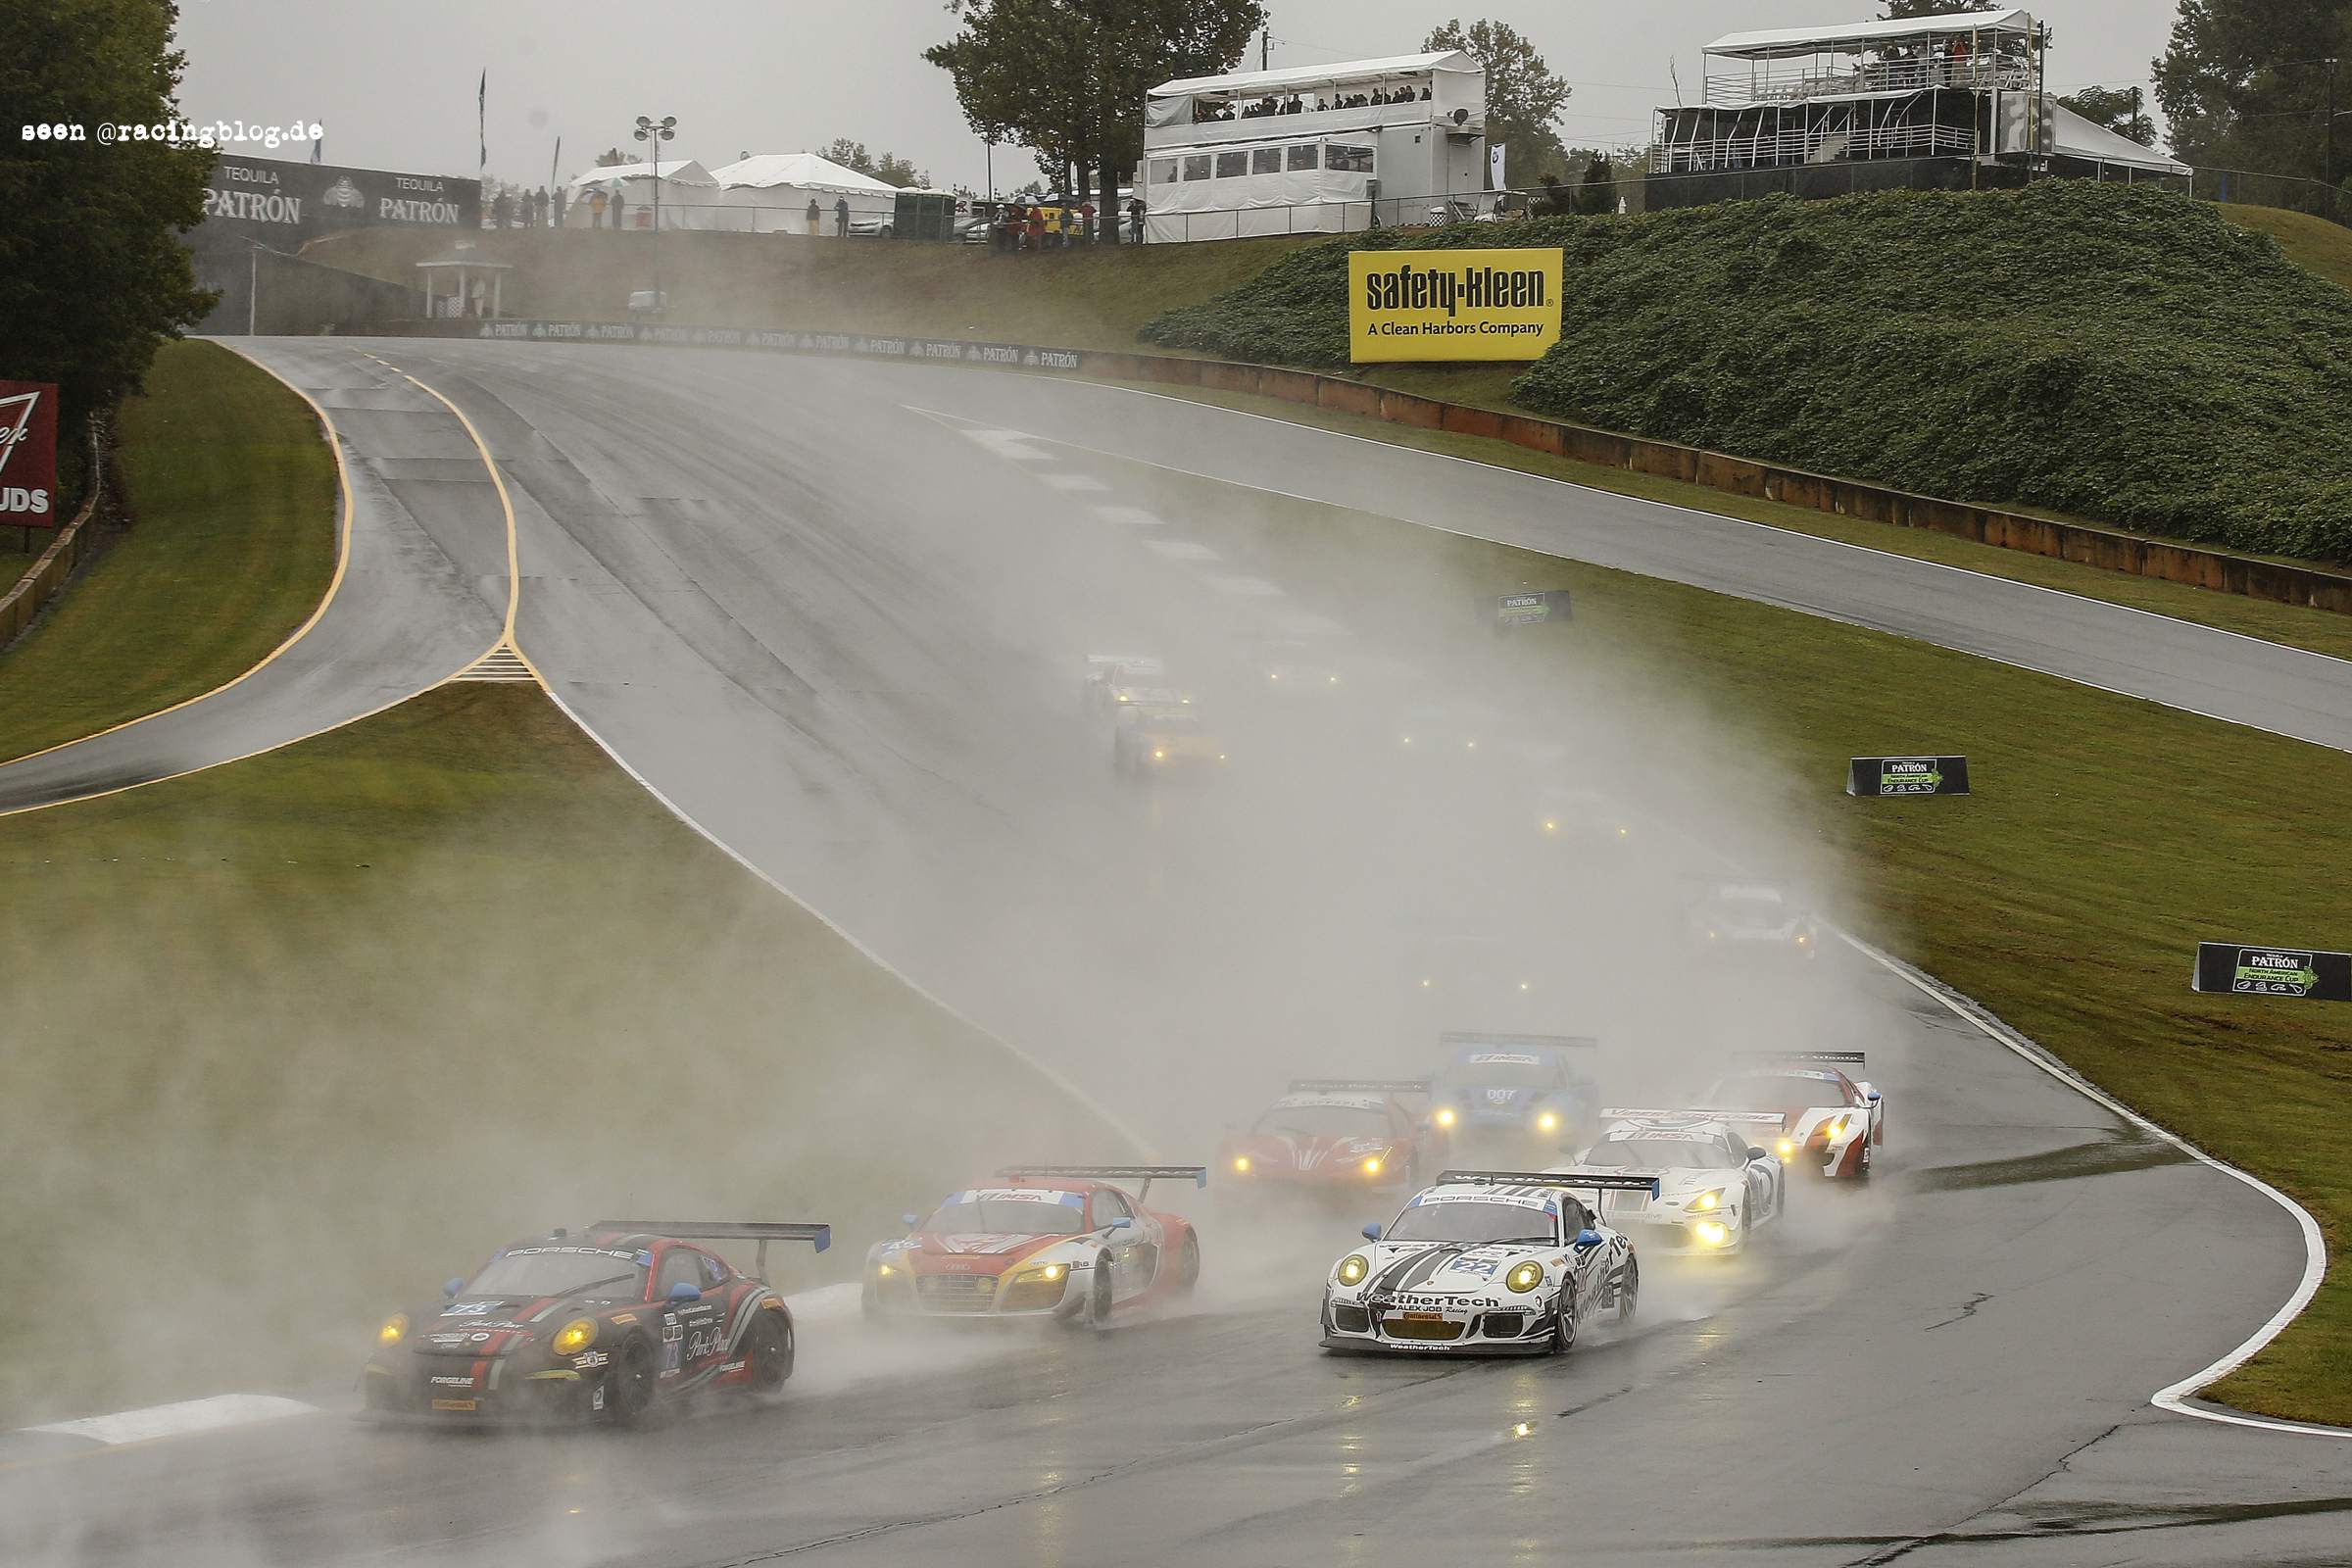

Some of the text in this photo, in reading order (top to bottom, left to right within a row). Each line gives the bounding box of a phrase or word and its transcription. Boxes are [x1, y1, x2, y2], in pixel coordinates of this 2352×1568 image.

[223, 166, 280, 185] TEQUILA
[395, 177, 444, 192] TEQUILA
[200, 187, 302, 225] PATRÓN
[379, 197, 460, 224] PATRÓN
[1366, 265, 1544, 318] safety-kleen
[1367, 320, 1544, 337] A Clean Harbors Company
[983, 346, 1019, 363] PATRÓN
[1041, 352, 1078, 368] PATRÓN
[1891, 762, 1928, 772] PATRÓN
[2251, 956, 2299, 969] PATRÓN
[1424, 1196, 1539, 1206] PORSCHE
[506, 1247, 635, 1259] PORSCHE
[1455, 1261, 1493, 1273] 22
[1355, 1292, 1500, 1307] WeatherTech
